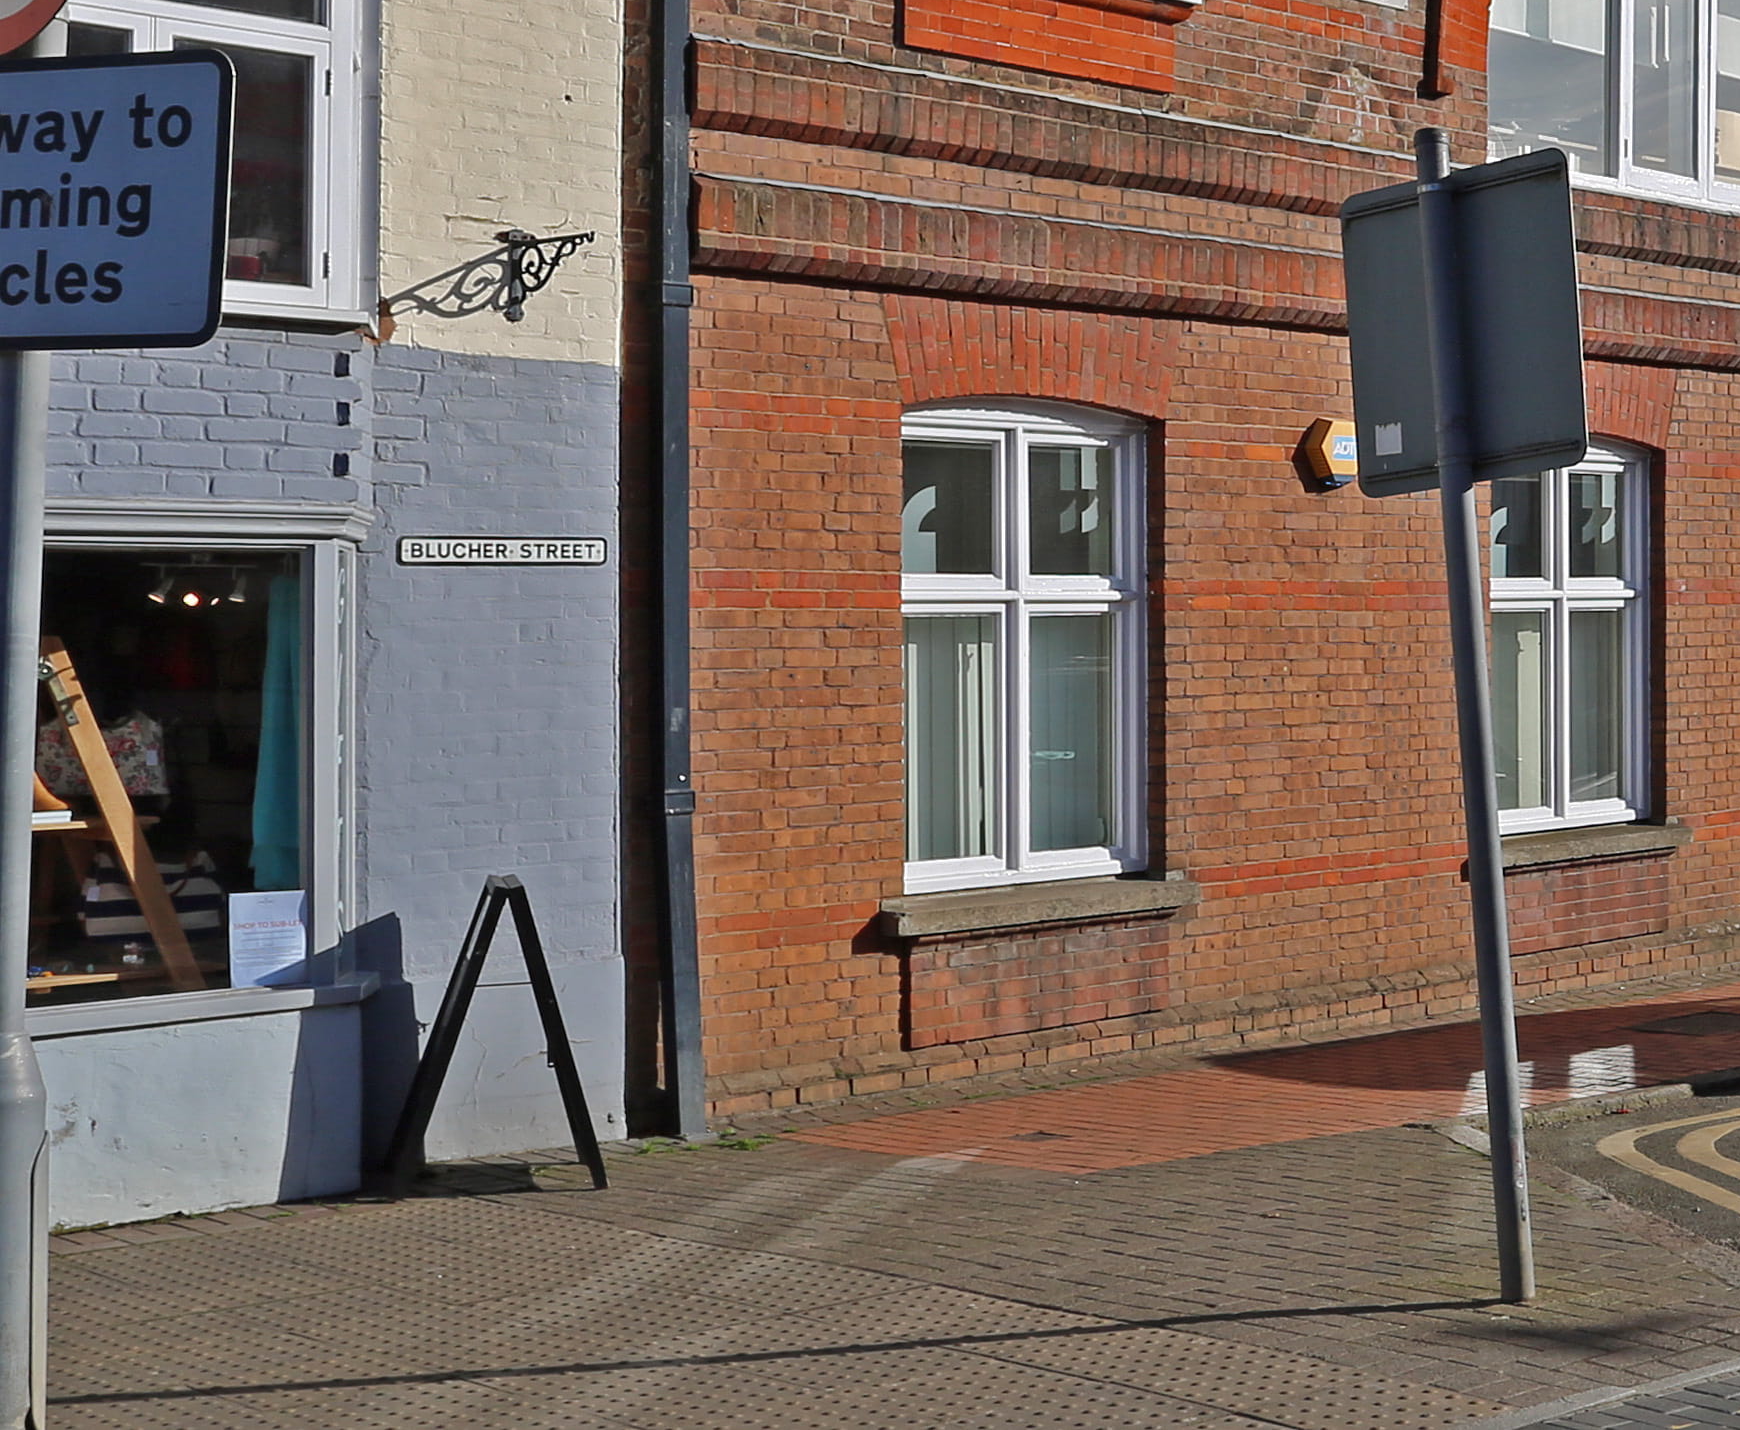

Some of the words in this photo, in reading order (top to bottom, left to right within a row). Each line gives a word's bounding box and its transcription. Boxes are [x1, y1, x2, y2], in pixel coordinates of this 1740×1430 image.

[129, 93, 192, 149] to
[410, 543, 508, 559] BLUCHER
[519, 543, 596, 559] STREET
